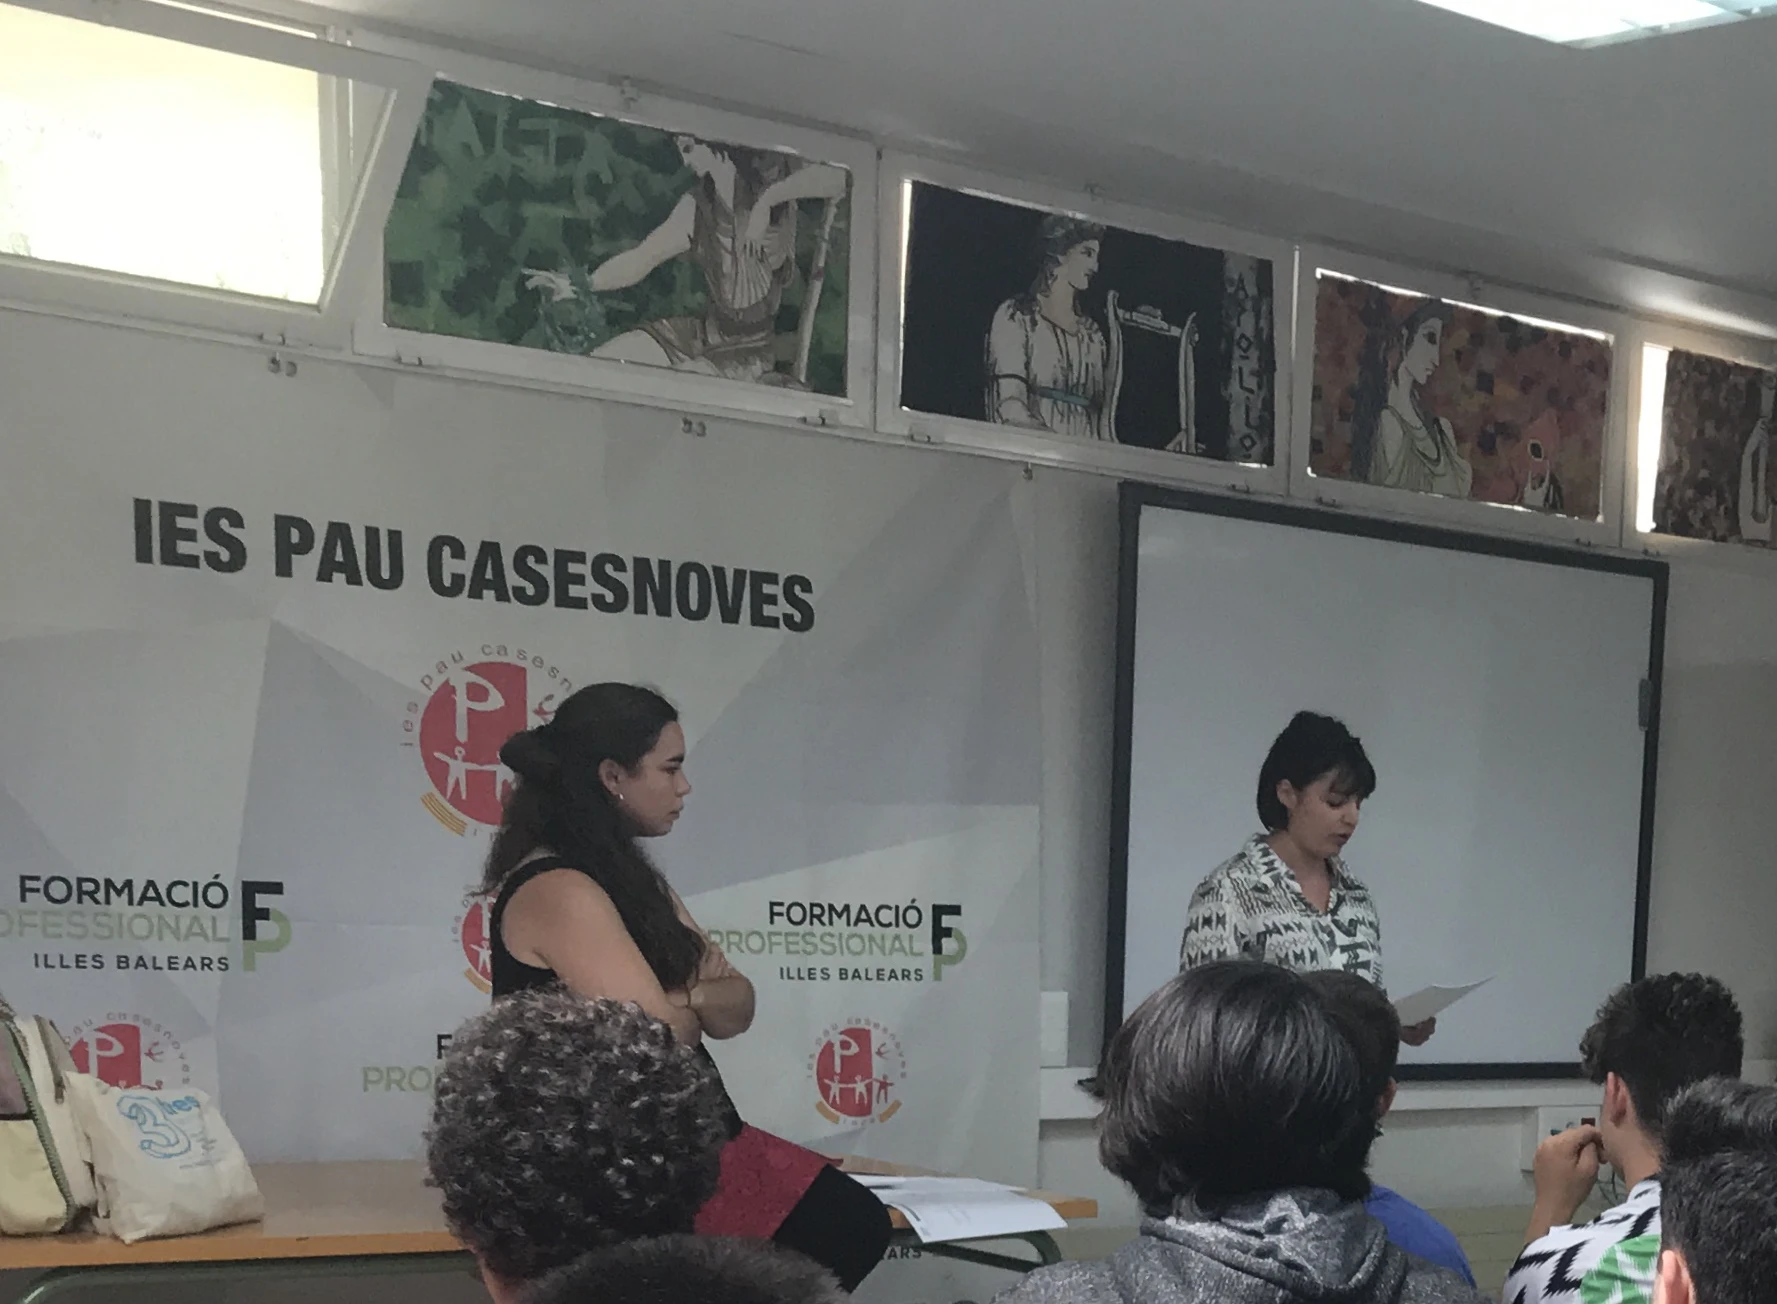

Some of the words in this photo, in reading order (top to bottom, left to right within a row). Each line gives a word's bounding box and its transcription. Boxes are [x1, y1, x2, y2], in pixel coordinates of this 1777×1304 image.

[131, 497, 247, 575] IES
[273, 513, 405, 591] PAU
[426, 535, 816, 633] CASESNOVES
[480, 643, 575, 692] casesn
[19, 873, 229, 910] FORMACIÓ
[768, 898, 923, 929] FORMACIÓ
[706, 929, 924, 958] PROFESSIONAL
[33, 952, 105, 970] ILLES
[116, 954, 230, 972] BALEARS
[779, 966, 831, 981] ILLES
[838, 967, 924, 982] BALEARS
